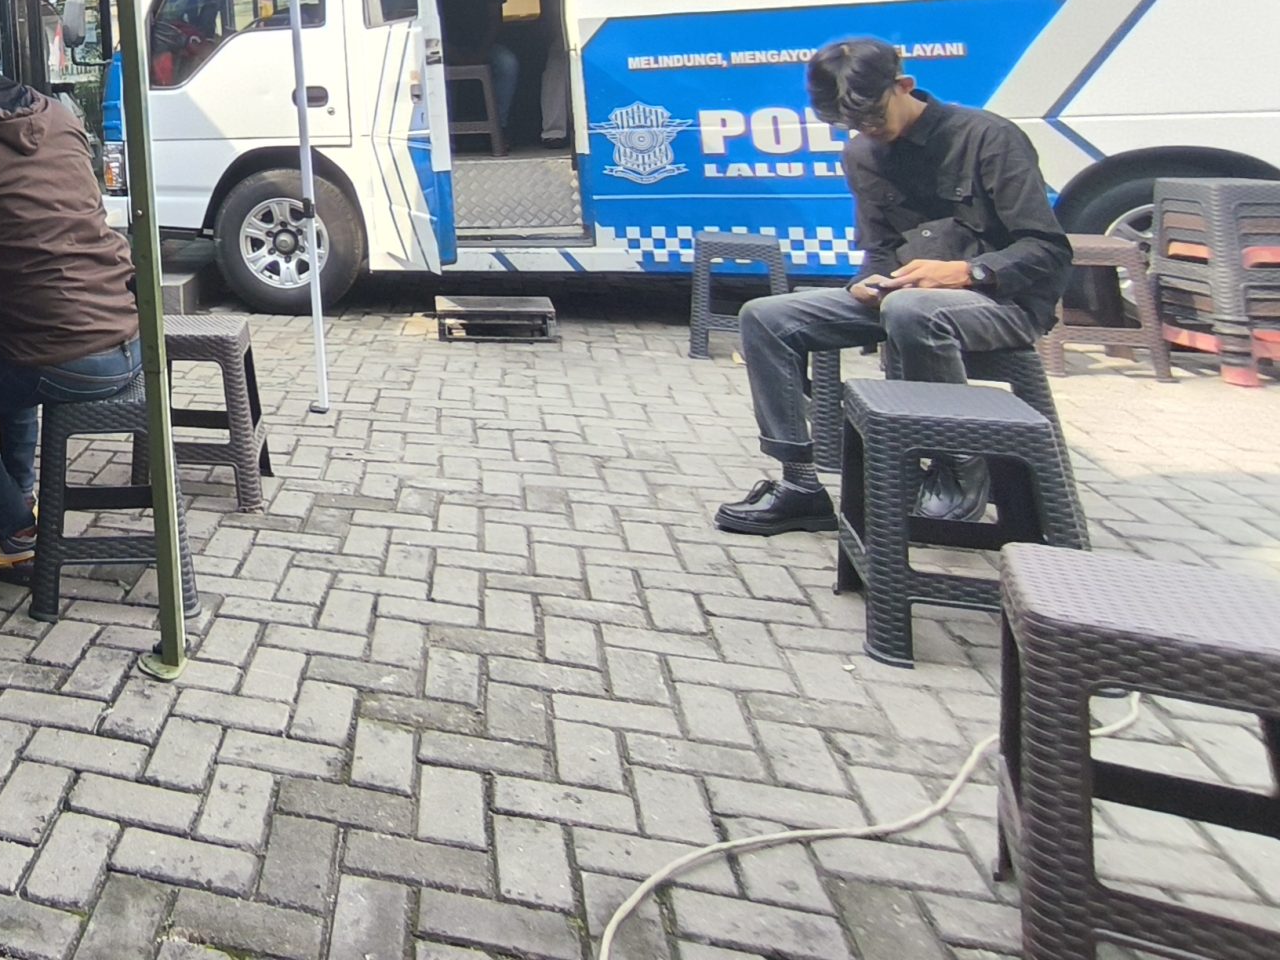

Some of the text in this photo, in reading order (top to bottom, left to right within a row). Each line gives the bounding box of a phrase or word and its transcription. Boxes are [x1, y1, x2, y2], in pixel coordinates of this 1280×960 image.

[627, 52, 727, 70] MELINDUNGI,
[698, 106, 860, 155] POL
[704, 161, 803, 177] LALU
